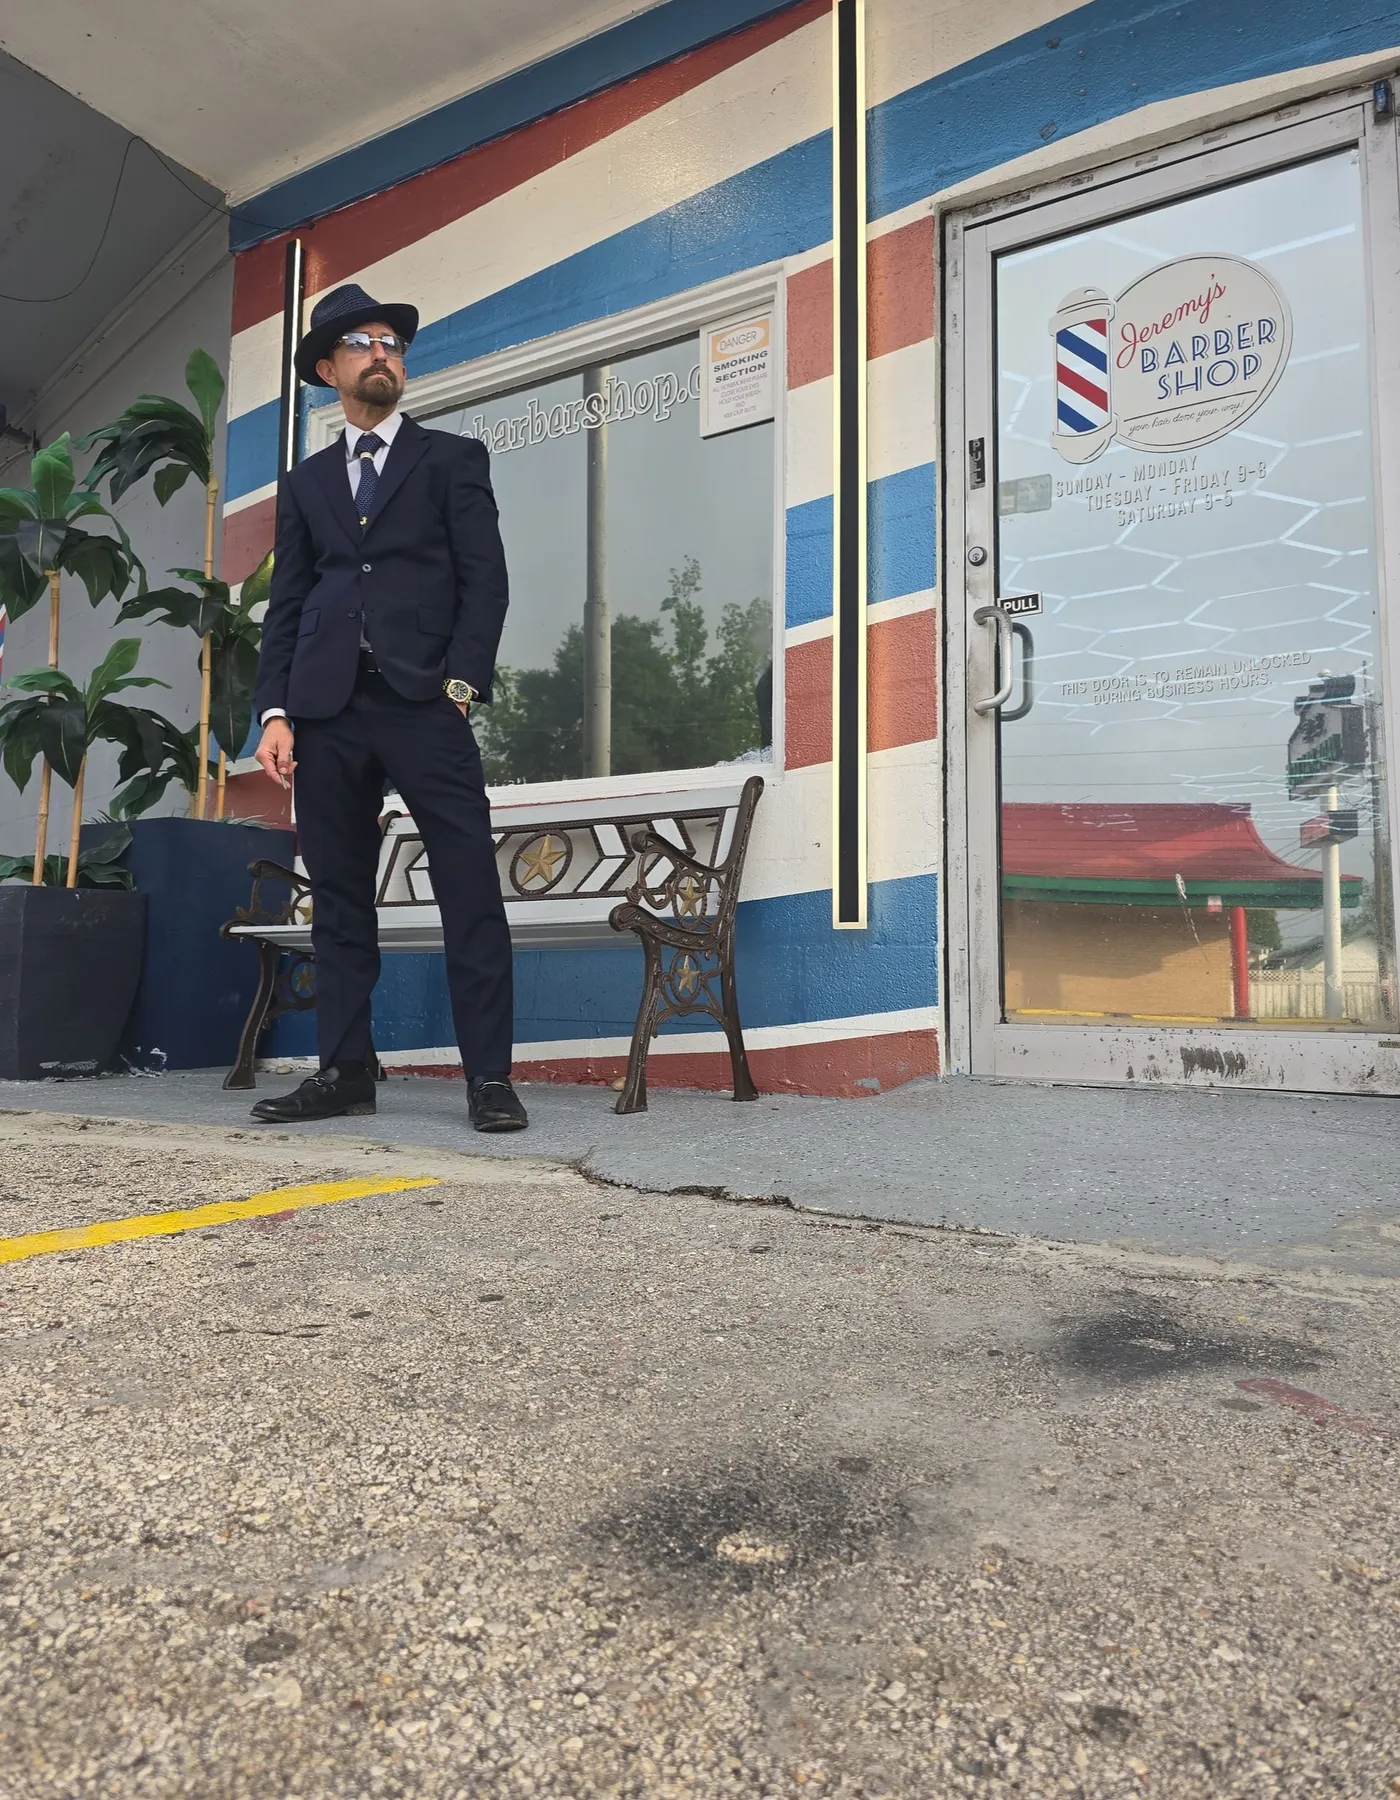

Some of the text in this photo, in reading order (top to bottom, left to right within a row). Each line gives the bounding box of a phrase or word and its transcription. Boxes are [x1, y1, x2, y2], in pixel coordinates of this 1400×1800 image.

[720, 330, 757, 351] DANGER
[1116, 273, 1226, 369] Jeremy's
[713, 350, 768, 373] SMOKING
[1141, 317, 1277, 373] BARBER
[715, 362, 766, 383] SECTION
[1158, 352, 1262, 400] SHOP
[459, 364, 700, 454] barbershop.
[1055, 472, 1113, 498] SUNDAY
[1133, 455, 1197, 482] MONDAY
[1086, 485, 1152, 512] TUESDAY
[1174, 470, 1230, 496] FRIDAY
[1238, 460, 1268, 483] 9-8
[1117, 489, 1233, 527] SATURDAY 9-5
[1004, 597, 1037, 612] PULL
[1059, 651, 1312, 696] THIS DOOR IS TO REMAIN UNLOCKED
[1092, 672, 1273, 706] DURING BUSINESS HOURS.
